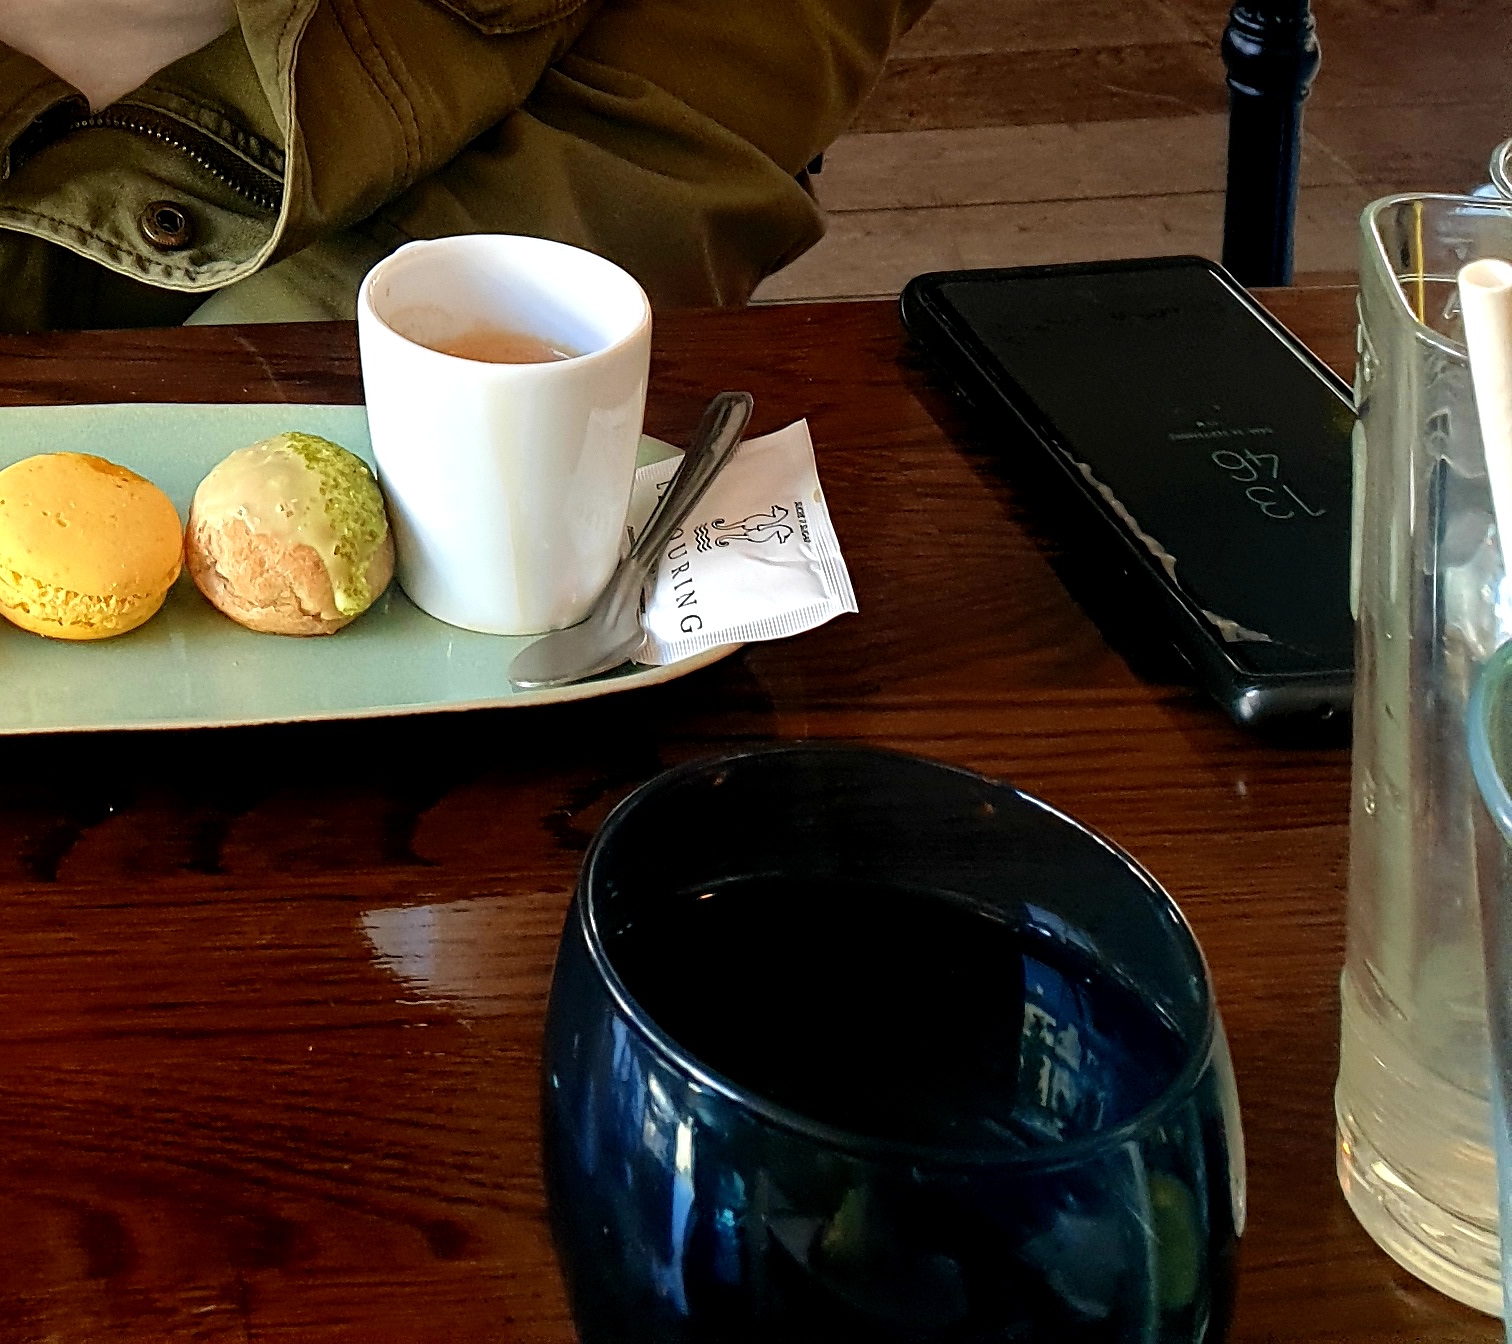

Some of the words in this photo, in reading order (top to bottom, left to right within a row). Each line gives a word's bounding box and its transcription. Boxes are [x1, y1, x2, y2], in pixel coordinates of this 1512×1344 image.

[1210, 448, 1279, 483] 46
[1244, 484, 1327, 520] 13
[666, 517, 703, 634] OURING
